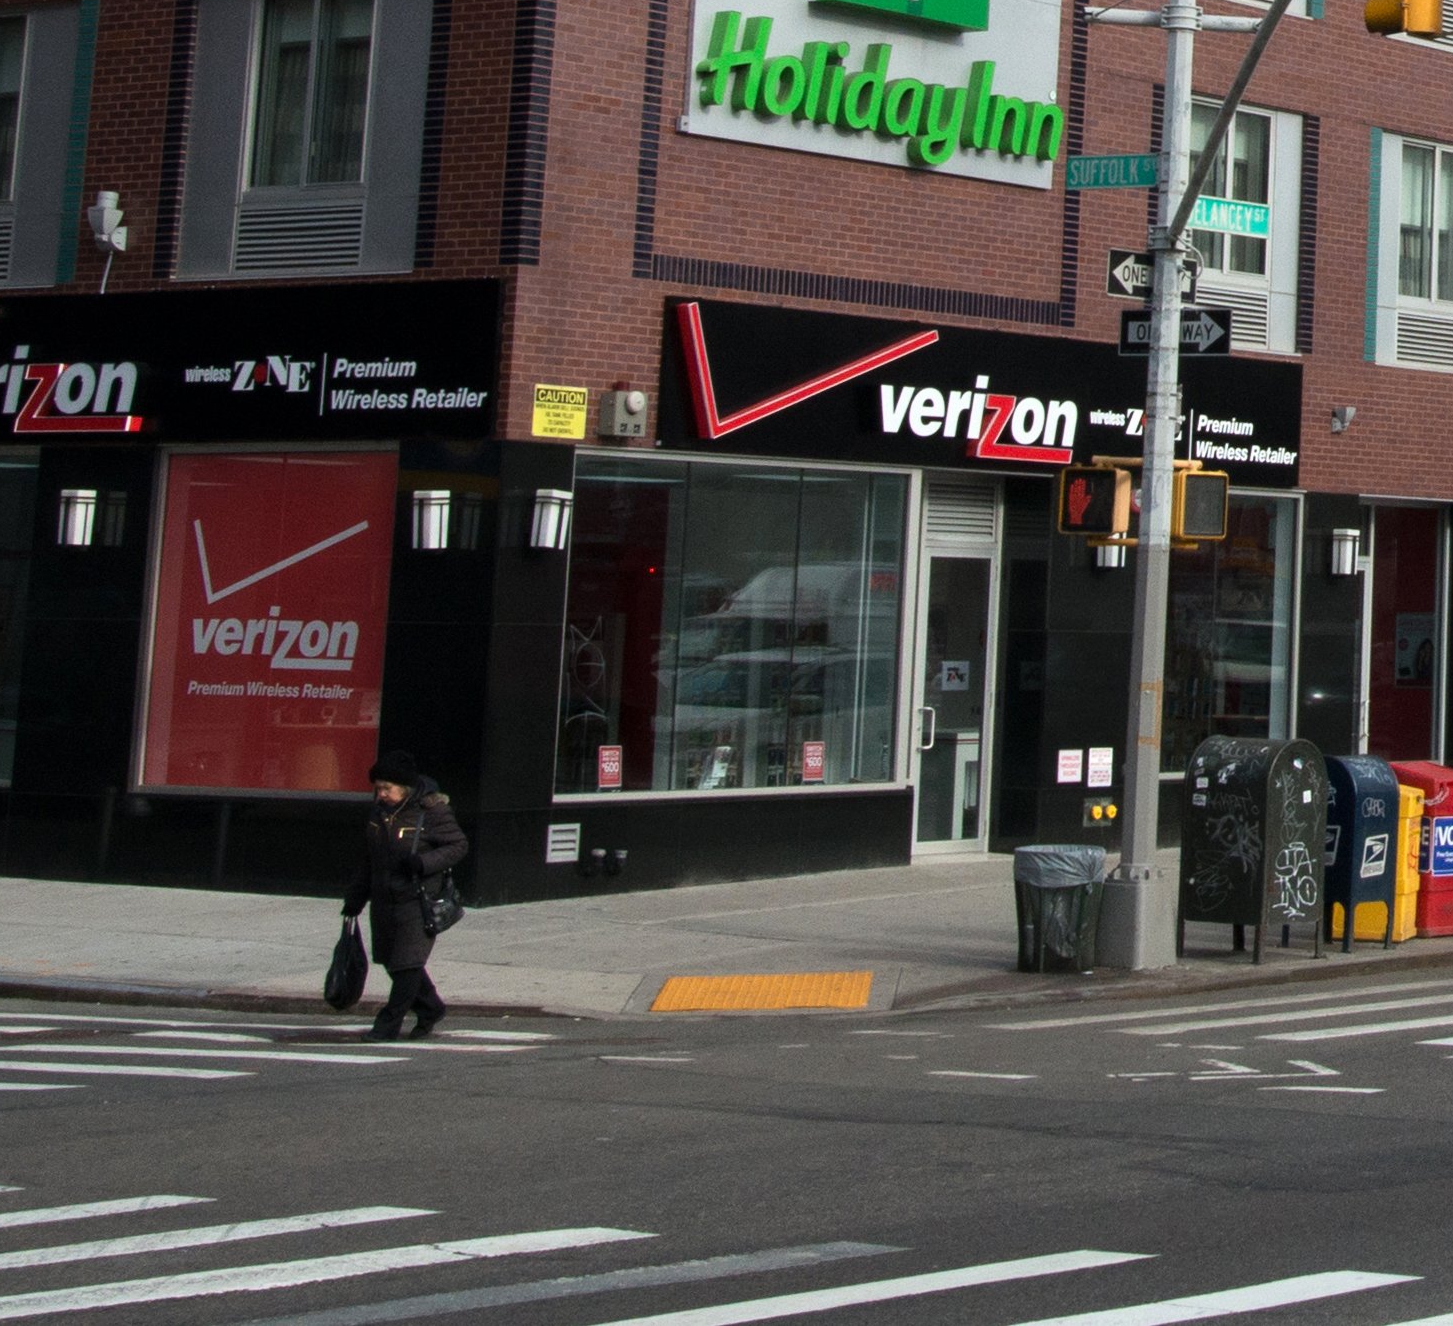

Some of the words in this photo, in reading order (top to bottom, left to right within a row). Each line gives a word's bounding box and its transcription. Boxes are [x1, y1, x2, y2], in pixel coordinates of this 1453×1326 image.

[1069, 158, 1139, 186] SUFFOLK
[1254, 208, 1266, 223] ST
[1122, 264, 1147, 284] ONE
[1182, 323, 1215, 341] WAY
[185, 365, 232, 383] wireless
[333, 357, 417, 378] Premium
[330, 389, 408, 410] Wireless
[411, 387, 487, 409] Retailer
[538, 389, 584, 404] CAUTION
[880, 375, 1078, 464] verizon
[1090, 409, 1125, 427] wireless
[1197, 415, 1254, 437] Premium
[1196, 440, 1249, 462] Wireless
[1249, 444, 1297, 466] Retailer
[193, 606, 359, 671] verizon
[187, 680, 244, 696] Premium
[246, 681, 299, 698] Wireless
[302, 683, 354, 699] Retailer
